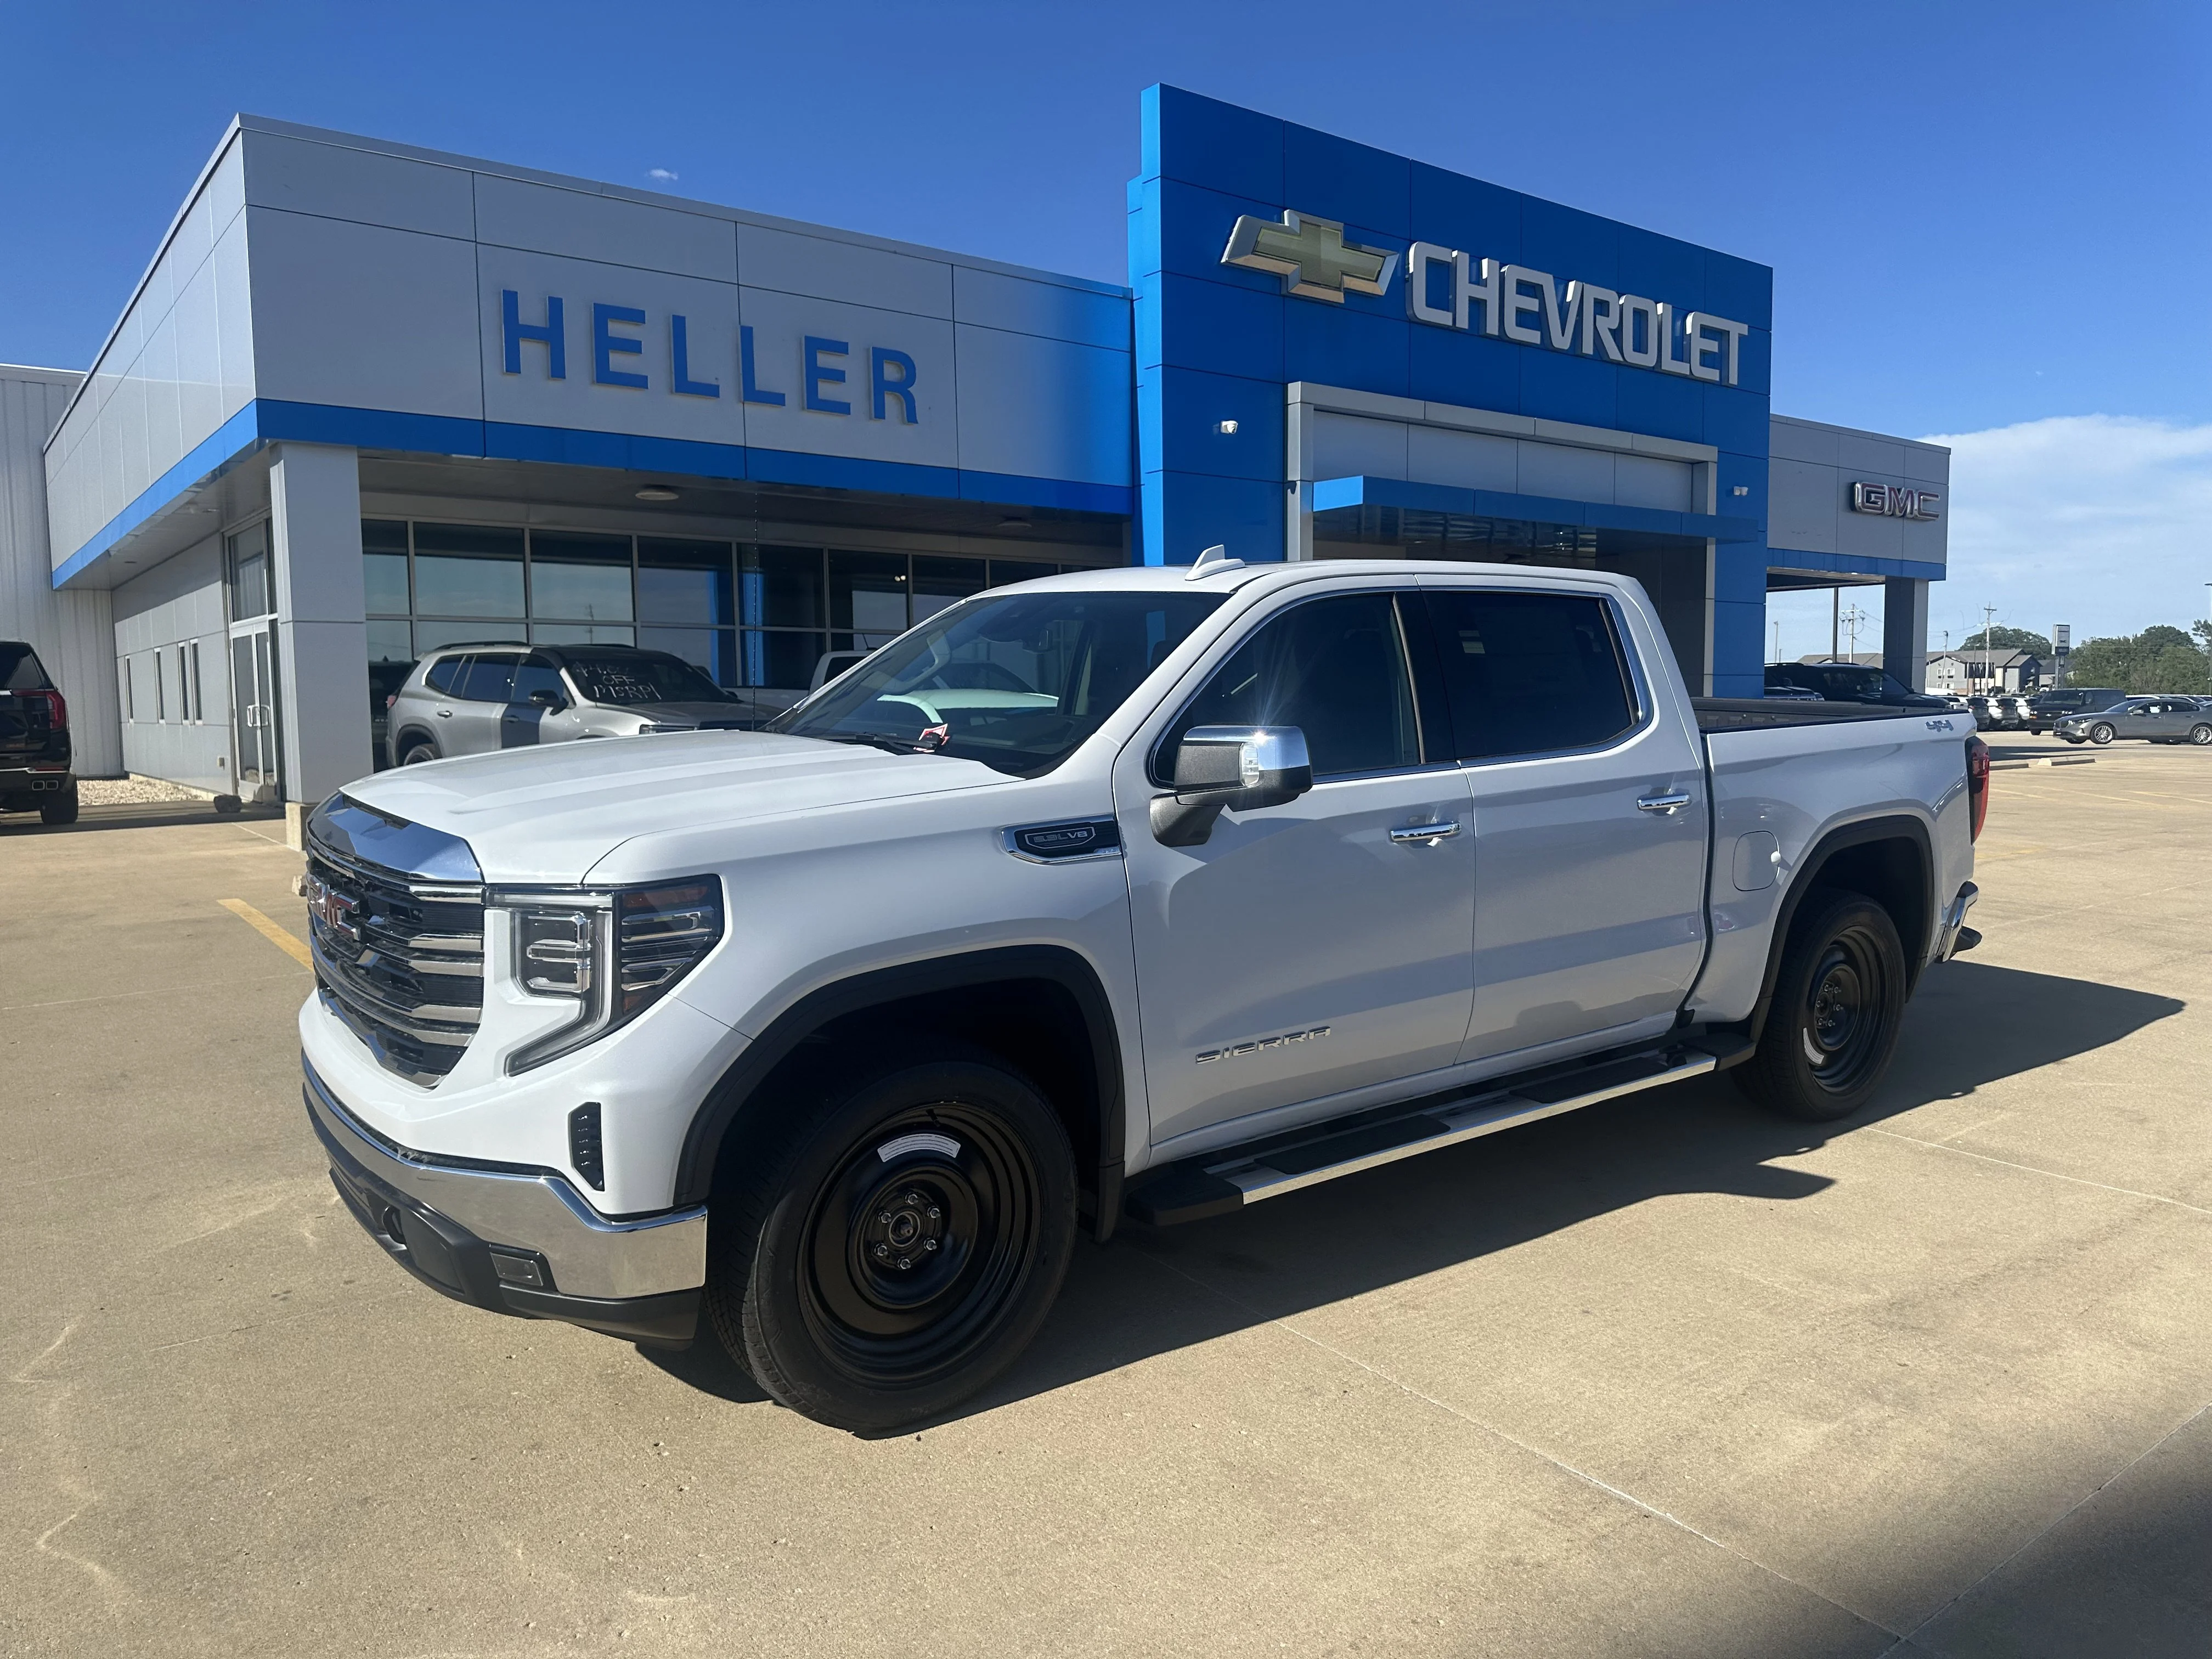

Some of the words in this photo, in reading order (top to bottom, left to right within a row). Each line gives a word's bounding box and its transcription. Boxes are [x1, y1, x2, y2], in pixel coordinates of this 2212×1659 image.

[1406, 241, 1748, 386] CHEVROLET
[501, 289, 918, 424] HELLER
[1854, 482, 1940, 521] GMC
[603, 675, 635, 685] OFF
[306, 871, 360, 941] GMC
[1195, 1025, 1331, 1064] SIERRA
